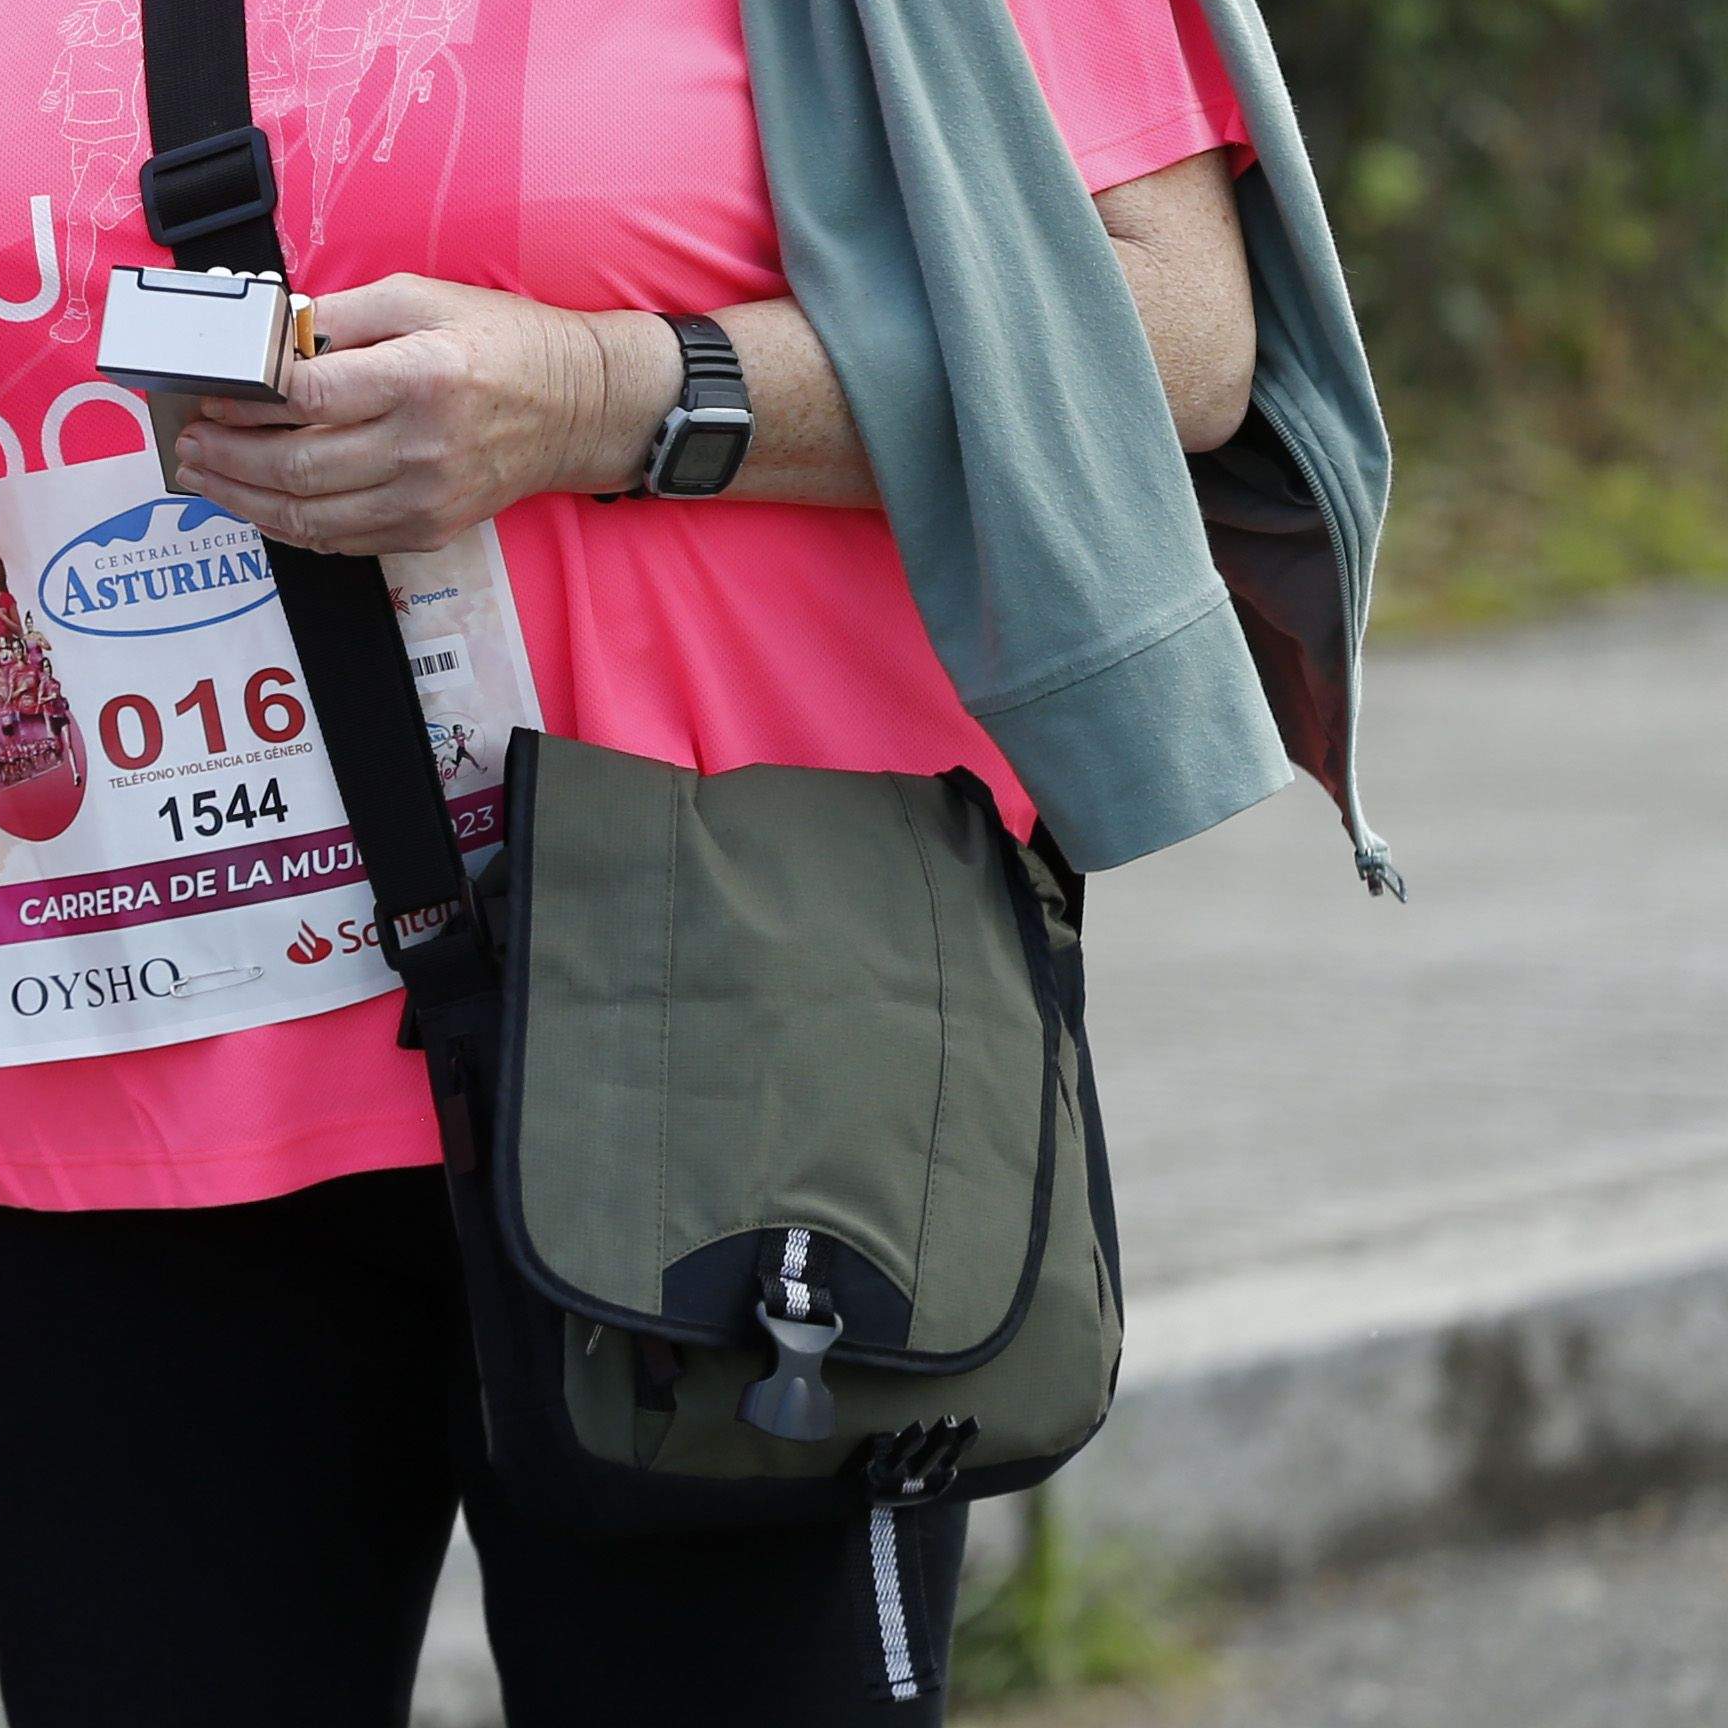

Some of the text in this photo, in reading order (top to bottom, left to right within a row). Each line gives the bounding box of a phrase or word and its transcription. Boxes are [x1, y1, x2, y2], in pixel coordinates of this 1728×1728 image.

[94, 528, 261, 570] CENTRAL LECHER
[410, 586, 459, 605] Deporte
[98, 666, 306, 771] 016
[109, 742, 313, 789] TELÉFONO VIOLENCIA DE GÉNERO
[158, 777, 288, 842] 1544
[19, 804, 495, 926] CARRERA DE LA MUJ 23
[11, 957, 182, 1016] OYSHO
